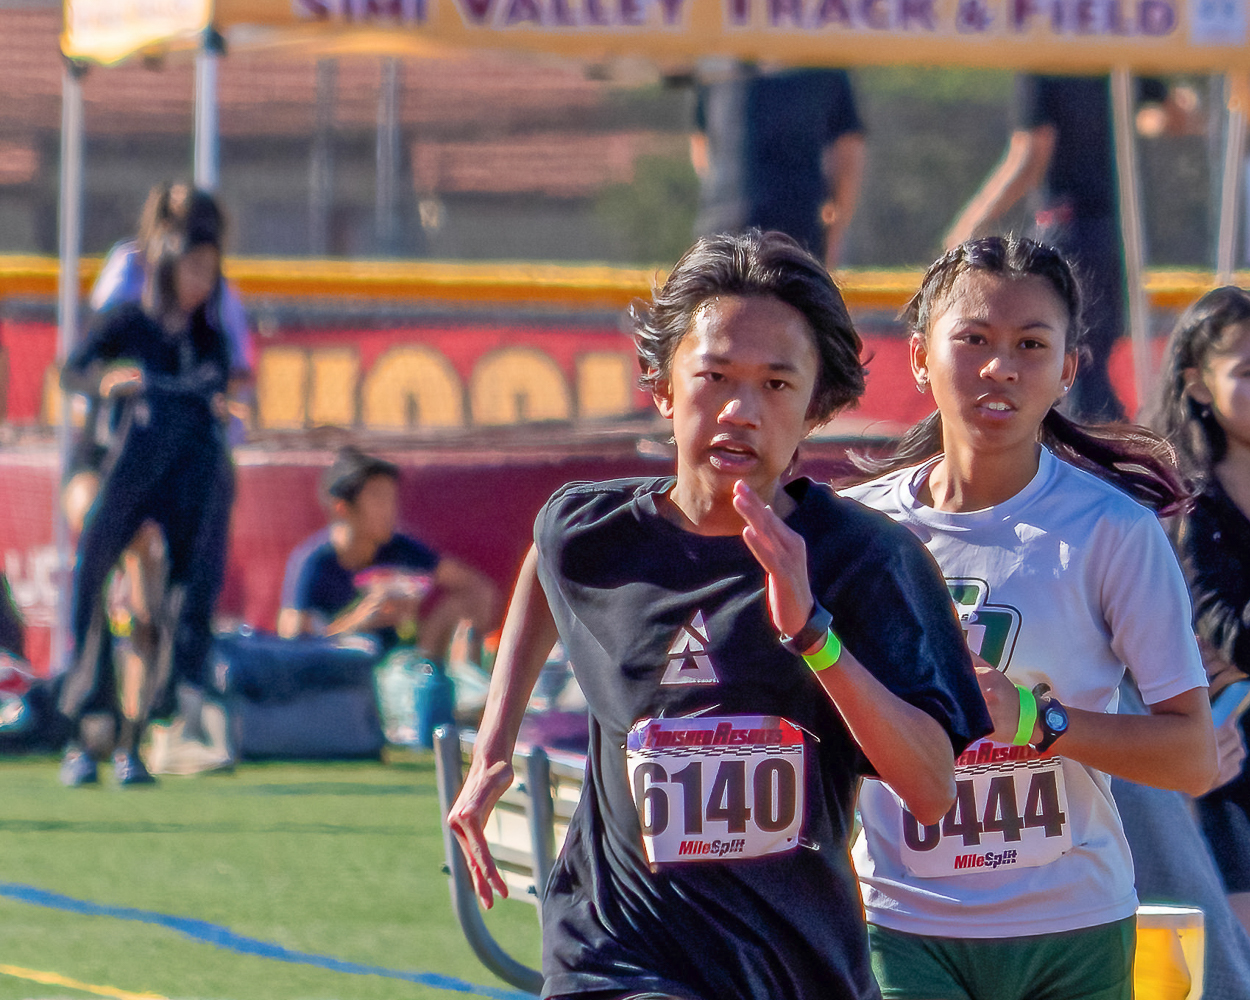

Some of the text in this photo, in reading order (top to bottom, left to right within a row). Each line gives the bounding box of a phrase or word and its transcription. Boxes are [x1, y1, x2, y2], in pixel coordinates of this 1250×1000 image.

[293, 0, 427, 25] SIMI
[457, 0, 691, 28] VALLEY
[725, 0, 940, 32] TRACK
[954, 0, 992, 35] &
[1000, 0, 1180, 37] FIELD
[634, 758, 797, 838] 6140
[678, 839, 746, 856] MileSplit
[953, 849, 1018, 870] MileSplit
